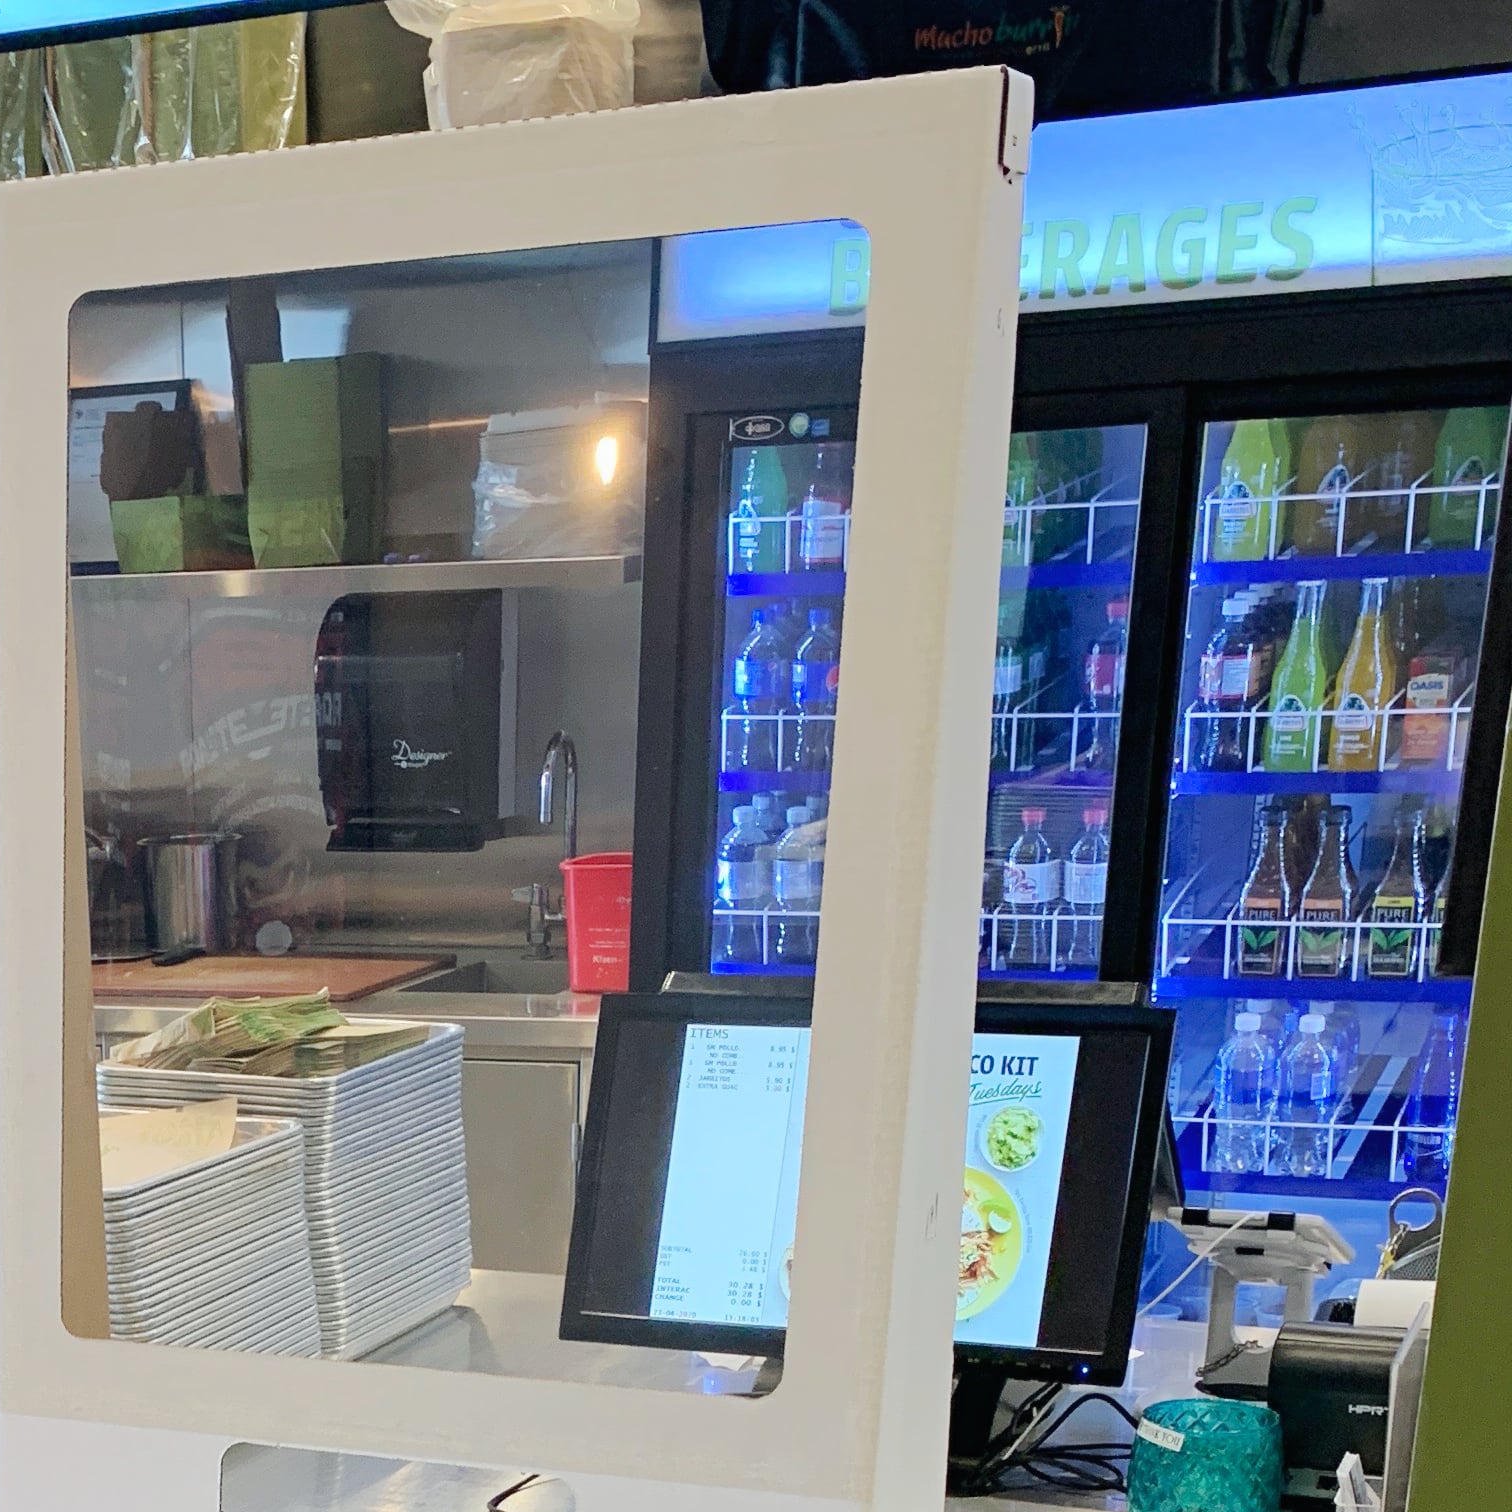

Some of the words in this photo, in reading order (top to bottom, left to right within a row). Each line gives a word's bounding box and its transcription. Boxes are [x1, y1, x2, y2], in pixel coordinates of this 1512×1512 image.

[1410, 681, 1444, 691] OASIS
[1248, 908, 1276, 921] PURE
[1306, 910, 1337, 922] PURE
[1377, 907, 1409, 922] PURE
[690, 1028, 729, 1039] ITEMS
[1001, 1056, 1039, 1075] KIT
